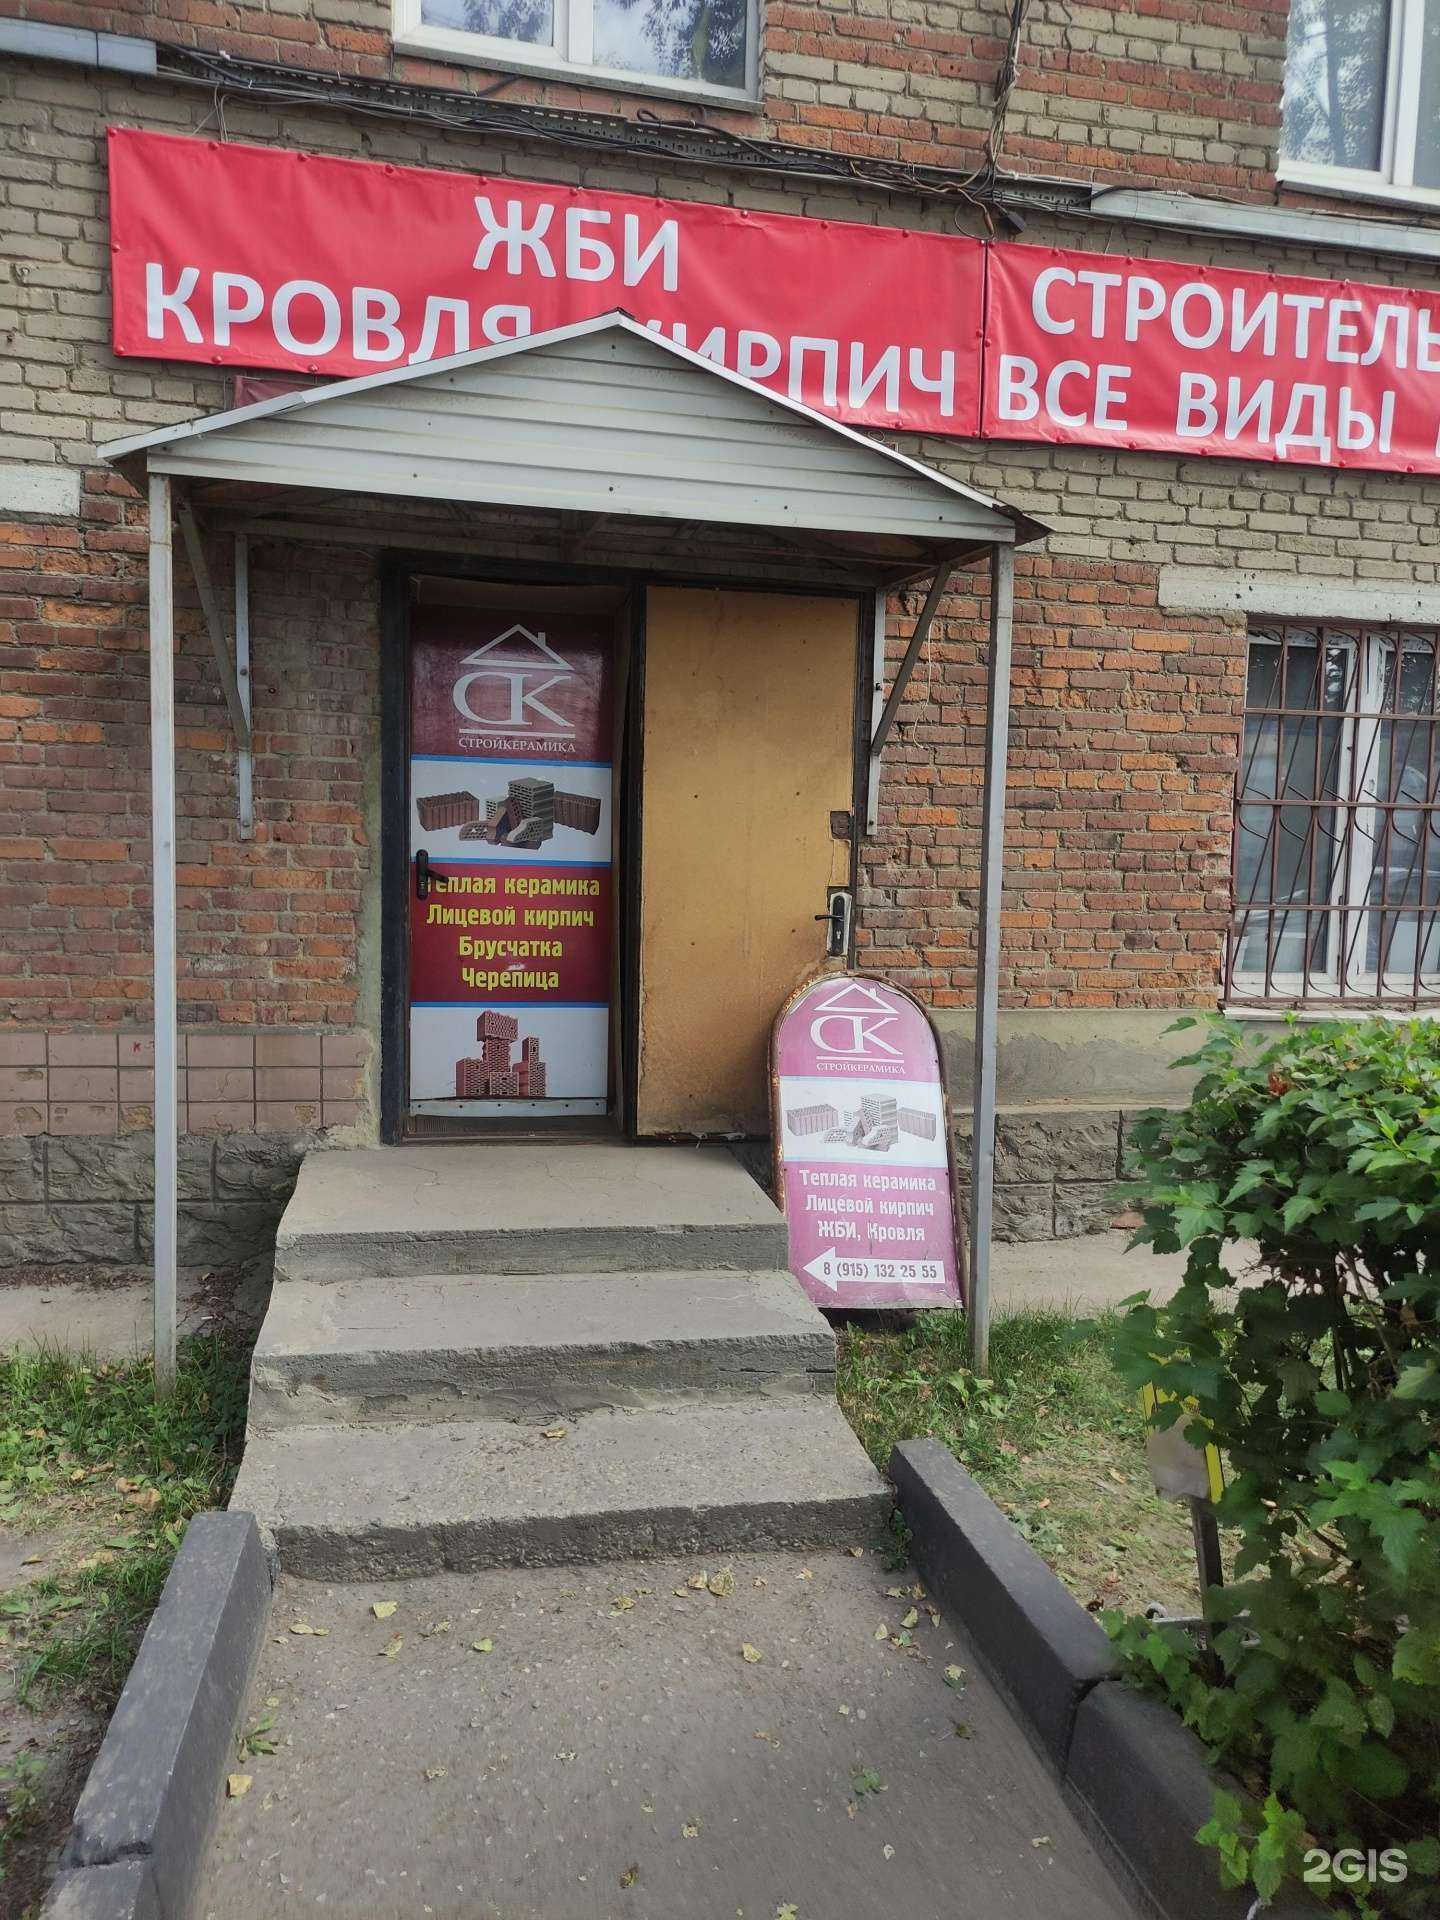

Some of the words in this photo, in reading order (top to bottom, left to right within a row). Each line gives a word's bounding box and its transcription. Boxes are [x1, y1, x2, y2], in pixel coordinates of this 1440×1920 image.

[473, 196, 678, 292] ЖБИ
[646, 320, 955, 417] ИРПИЧ
[998, 354, 1132, 431] ВСЕ
[1175, 371, 1396, 463] ВИДЫ
[458, 737, 576, 753] СТРОЙКЕРАМИКА
[427, 876, 496, 893] еплая
[504, 878, 600, 898] керамика
[426, 904, 516, 928] Лицевой
[524, 910, 594, 930] кирпич
[459, 936, 563, 960] Брусчатка
[462, 968, 559, 991] Черепица
[800, 1169, 857, 1188] Теплая
[863, 1174, 936, 1192] керамика
[805, 1194, 874, 1215] Лицевой
[879, 1202, 934, 1218] кирпич
[817, 1219, 861, 1241] ЖБИ,
[867, 1222, 925, 1242] Кровля
[823, 1261, 831, 1276] 8
[837, 1262, 869, 1279] (915)
[874, 1263, 895, 1278] 132
[900, 1264, 916, 1278] 25
[922, 1265, 937, 1279] 55
